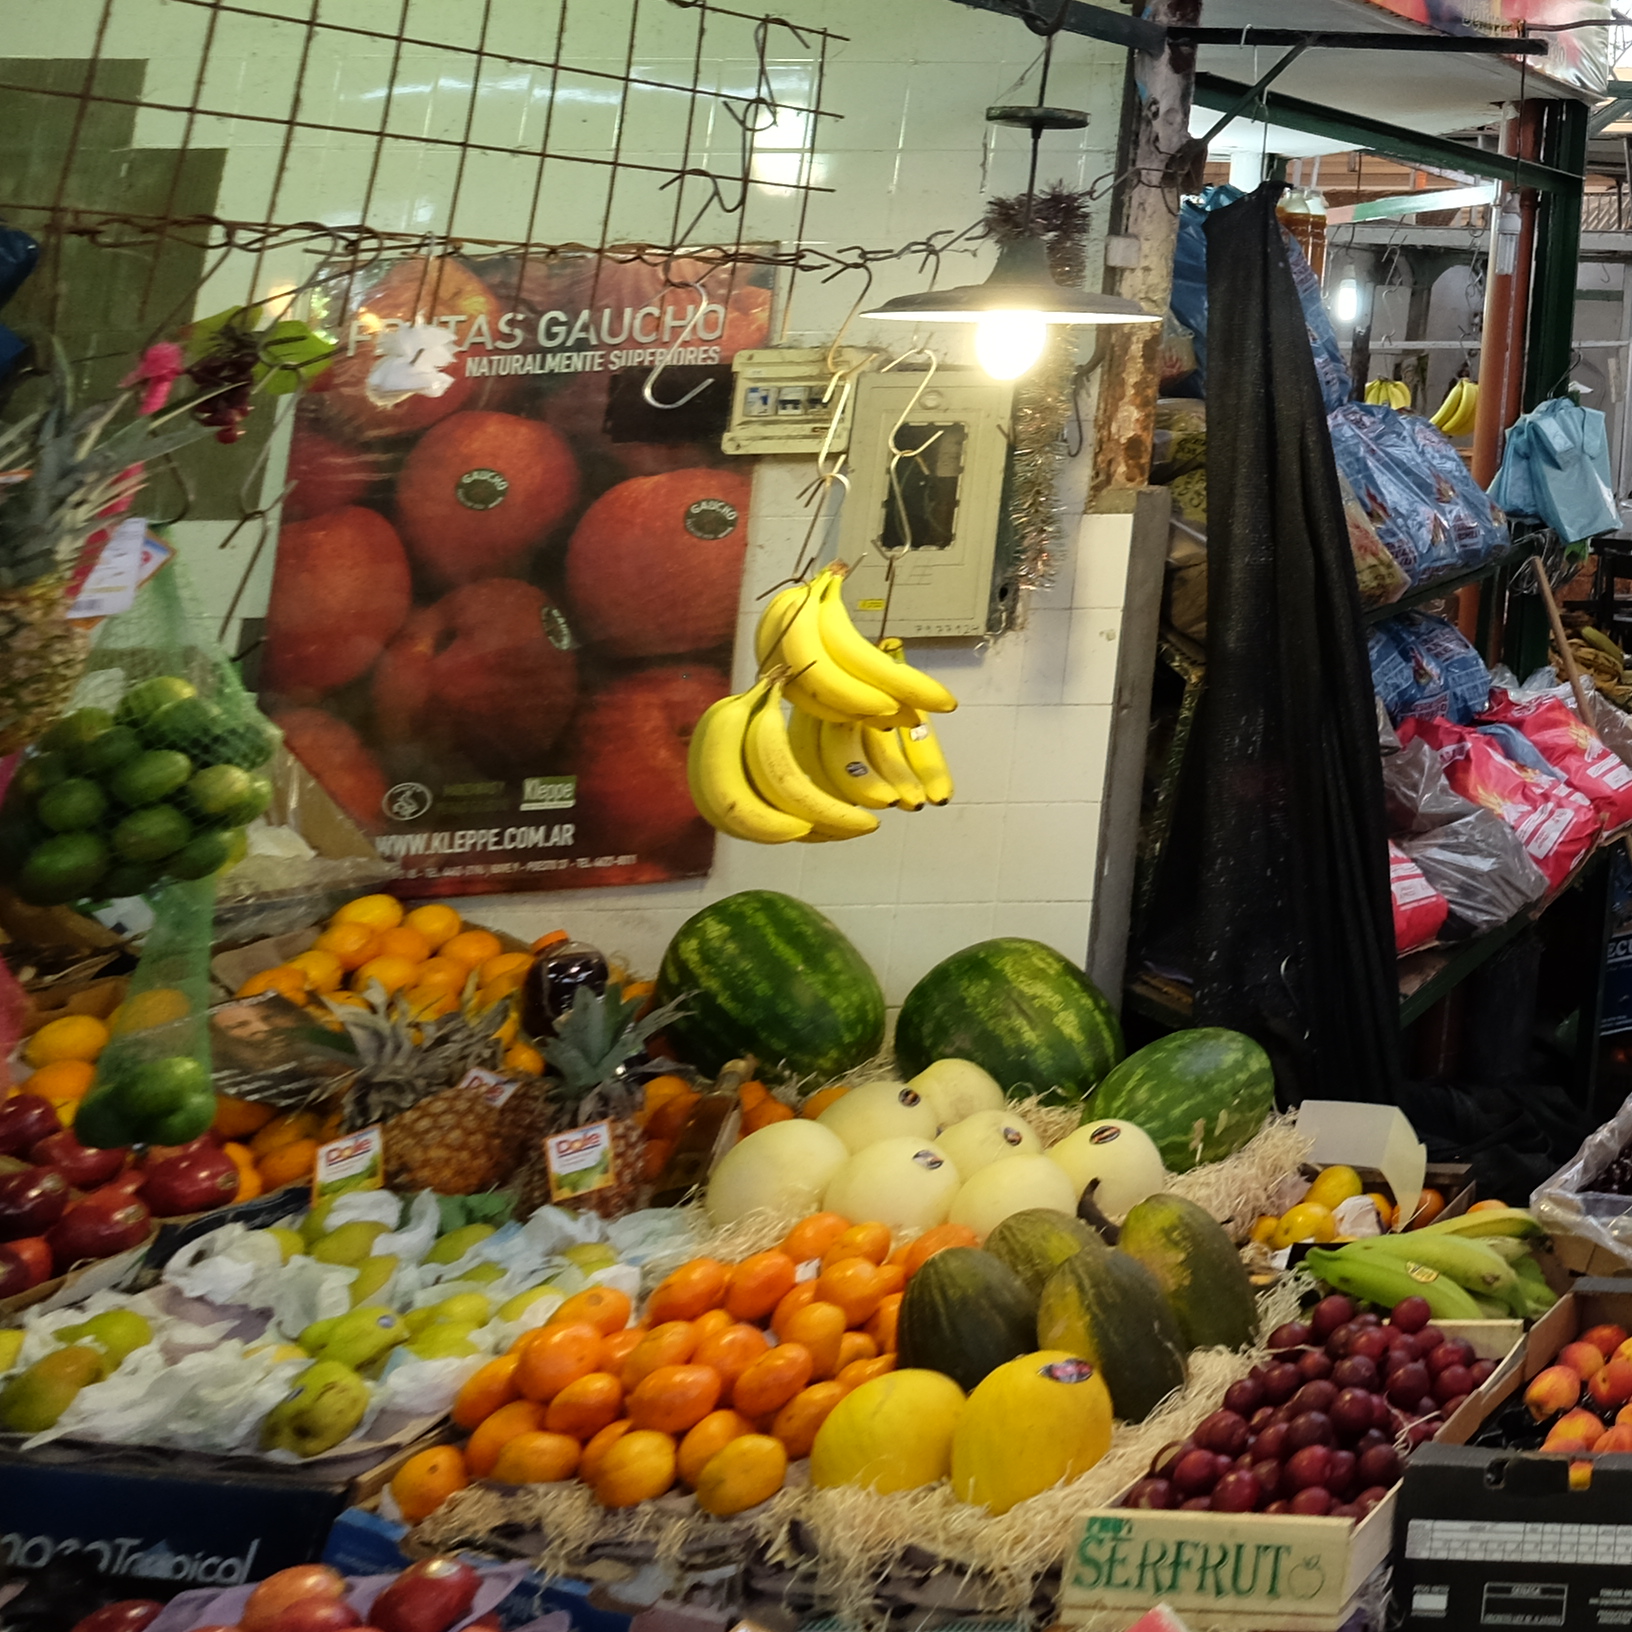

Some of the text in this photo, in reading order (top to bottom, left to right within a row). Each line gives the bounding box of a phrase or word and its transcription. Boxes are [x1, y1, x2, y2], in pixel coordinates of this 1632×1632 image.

[536, 302, 725, 350] GAUCHO
[464, 351, 604, 378] NATURALMENTE
[461, 468, 509, 490] GAUCHO
[690, 499, 738, 521] GAUCHO
[523, 778, 575, 804] Kleppe
[376, 824, 576, 858] WWW.KLEPPE.COM.AR
[327, 1137, 372, 1163] Dole
[556, 1132, 600, 1154] Dole
[1071, 1531, 1292, 1598] SERFRUT
